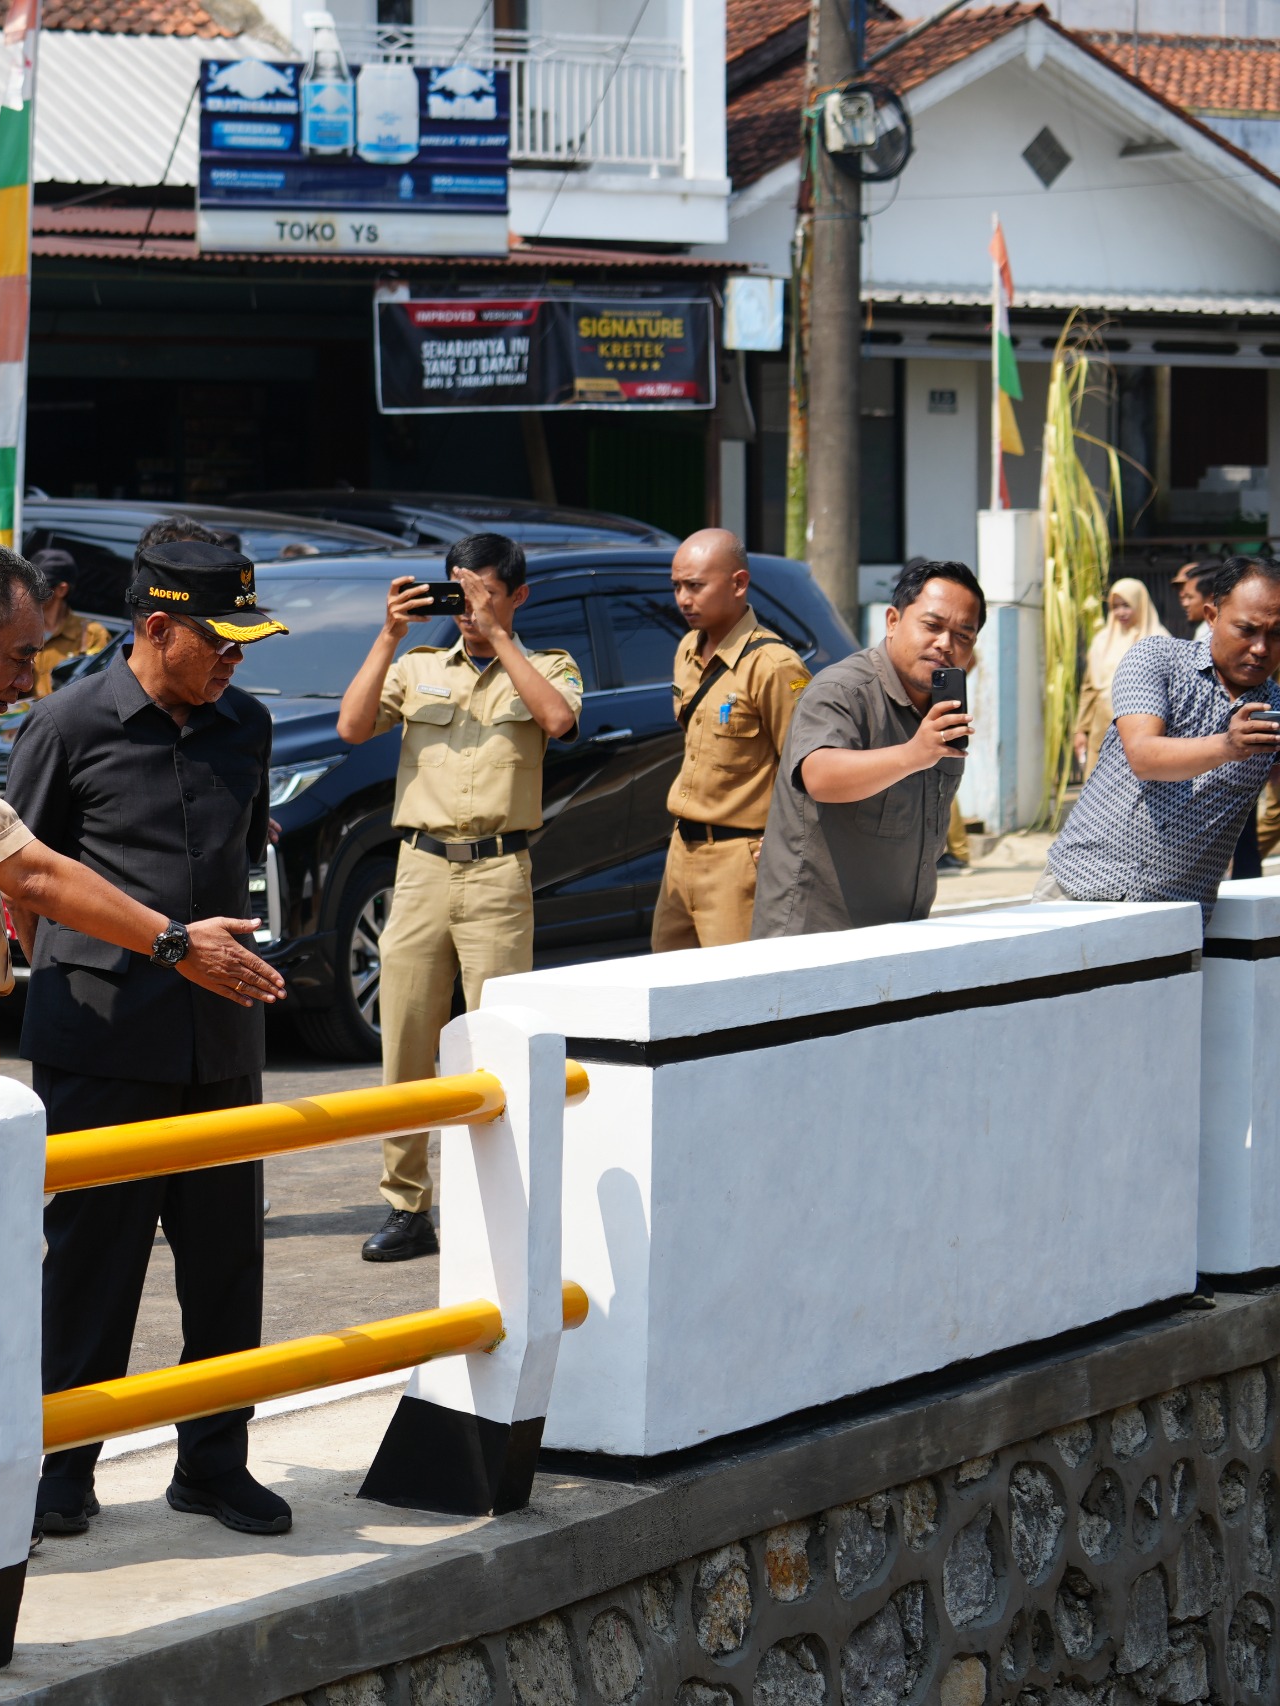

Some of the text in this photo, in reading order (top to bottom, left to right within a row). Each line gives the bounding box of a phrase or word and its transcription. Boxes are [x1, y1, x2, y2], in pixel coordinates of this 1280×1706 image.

[277, 220, 379, 243] TOKO YS
[415, 310, 523, 322] IMPROVED VERSION
[578, 317, 684, 339] SIGNATURE
[597, 341, 665, 358] KRETEK
[149, 587, 190, 601] SADEWO
